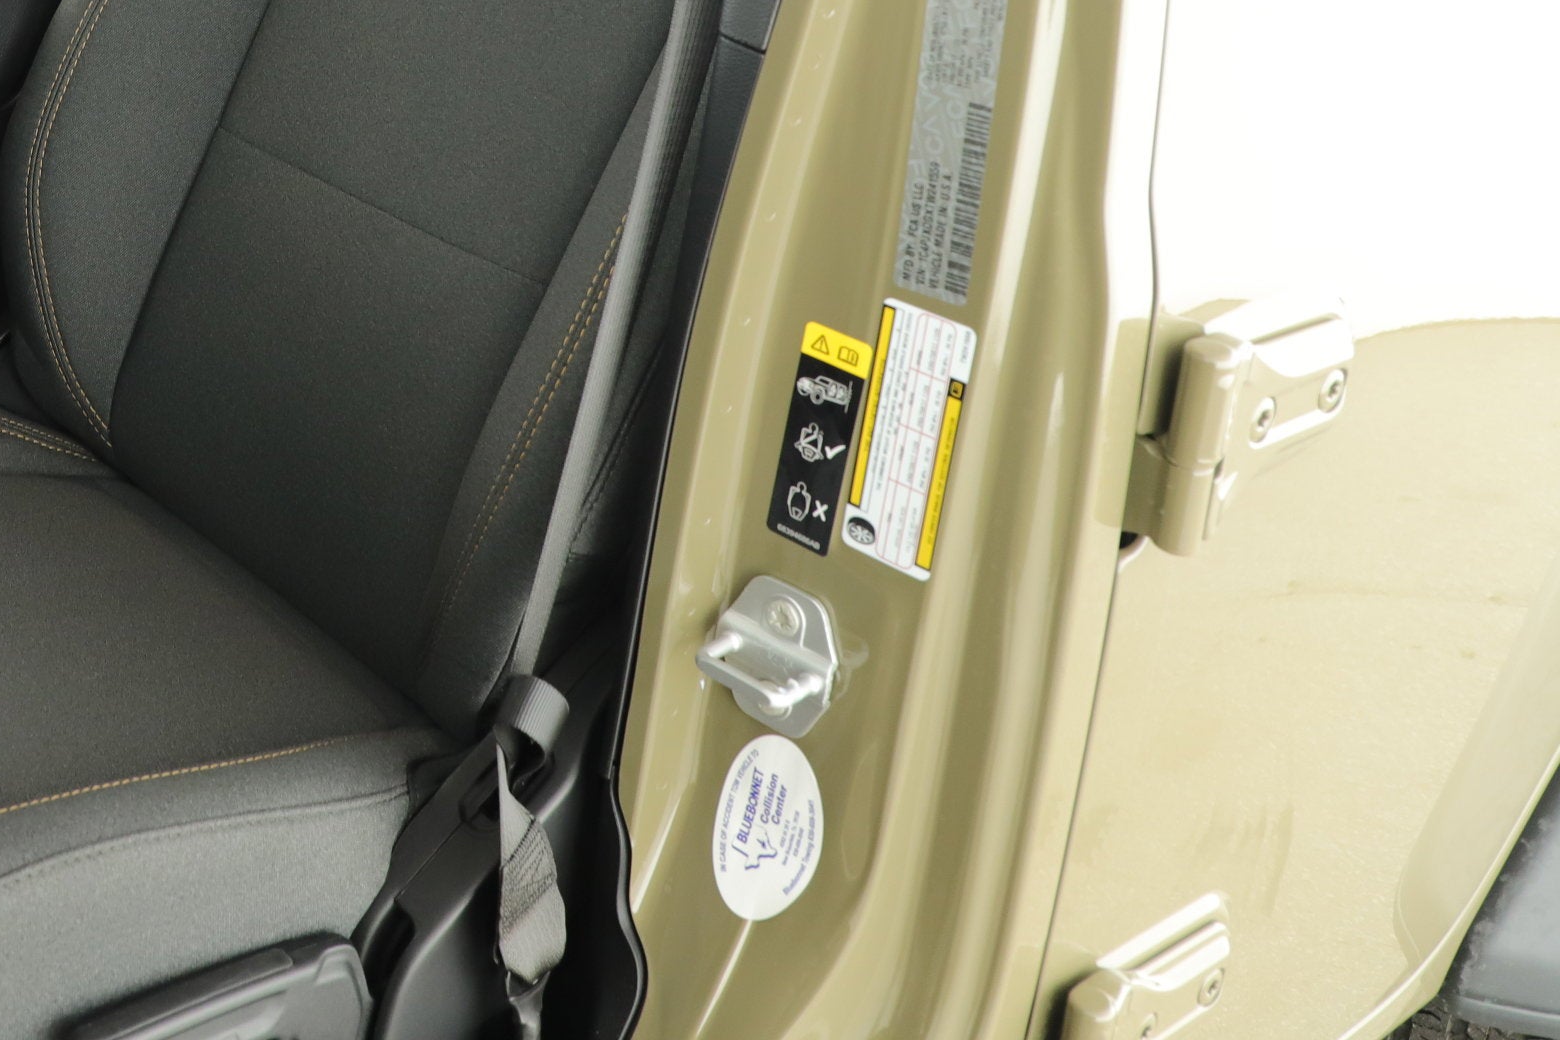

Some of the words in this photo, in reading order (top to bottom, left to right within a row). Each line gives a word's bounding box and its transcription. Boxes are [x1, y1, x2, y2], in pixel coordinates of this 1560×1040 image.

[913, 182, 925, 200] LLC
[911, 202, 922, 217] US
[938, 206, 948, 219] IN
[907, 219, 919, 238] FCA
[934, 220, 947, 248] MADE
[902, 259, 914, 281] MFD
[928, 250, 943, 289] VEHICLE
[737, 755, 754, 779] VEHICLE
[722, 793, 736, 828] ACCIDENT
[737, 766, 764, 844] BLUEBONNET
[760, 773, 779, 825] Collision
[771, 784, 787, 826] Center
[720, 829, 728, 840] OF
